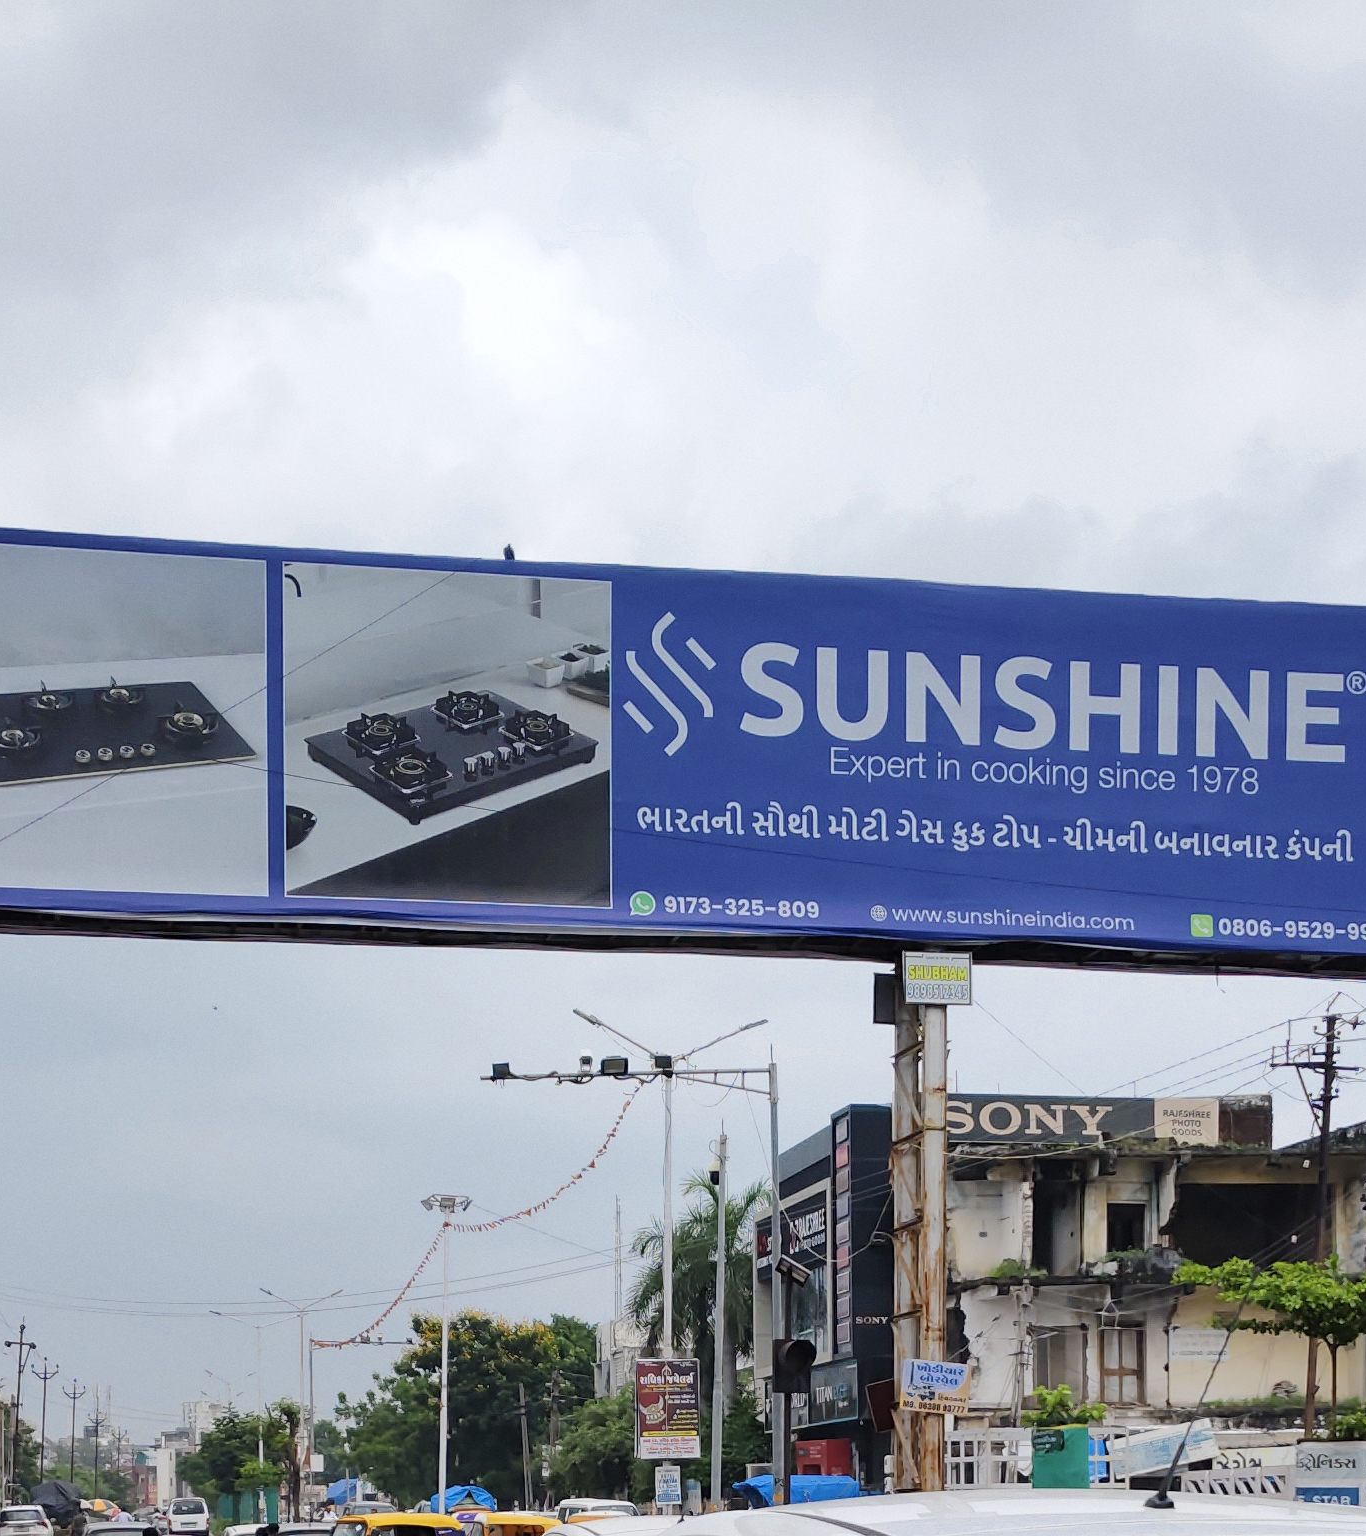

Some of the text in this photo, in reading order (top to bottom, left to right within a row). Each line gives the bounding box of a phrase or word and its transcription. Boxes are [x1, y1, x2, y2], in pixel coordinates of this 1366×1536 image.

[830, 747, 1260, 795] Expert in cooking since 1978
[637, 802, 745, 836] ભારતની
[752, 801, 821, 840] સૌથી
[827, 807, 890, 842] મોટી
[895, 810, 945, 845] ગેસ
[951, 821, 986, 852] કુક
[991, 813, 1042, 850] ટોપ
[1062, 818, 1149, 854] ચીમની
[1154, 830, 1280, 860] બનાવનાર
[1285, 829, 1354, 863] કંપની
[663, 895, 820, 920] 9173-325-809
[892, 904, 1135, 933] www.sunshineindia.com
[908, 965, 968, 981] SHUBHAM
[907, 983, 968, 1000] 9898512345
[946, 1100, 1113, 1137] SONY
[1163, 1110, 1211, 1118] RAJESHREE
[1171, 1119, 1201, 1127] PHOTO
[1172, 1128, 1202, 1136] GOODS
[856, 1316, 889, 1325] SONY
[816, 1385, 833, 1404] TITAN
